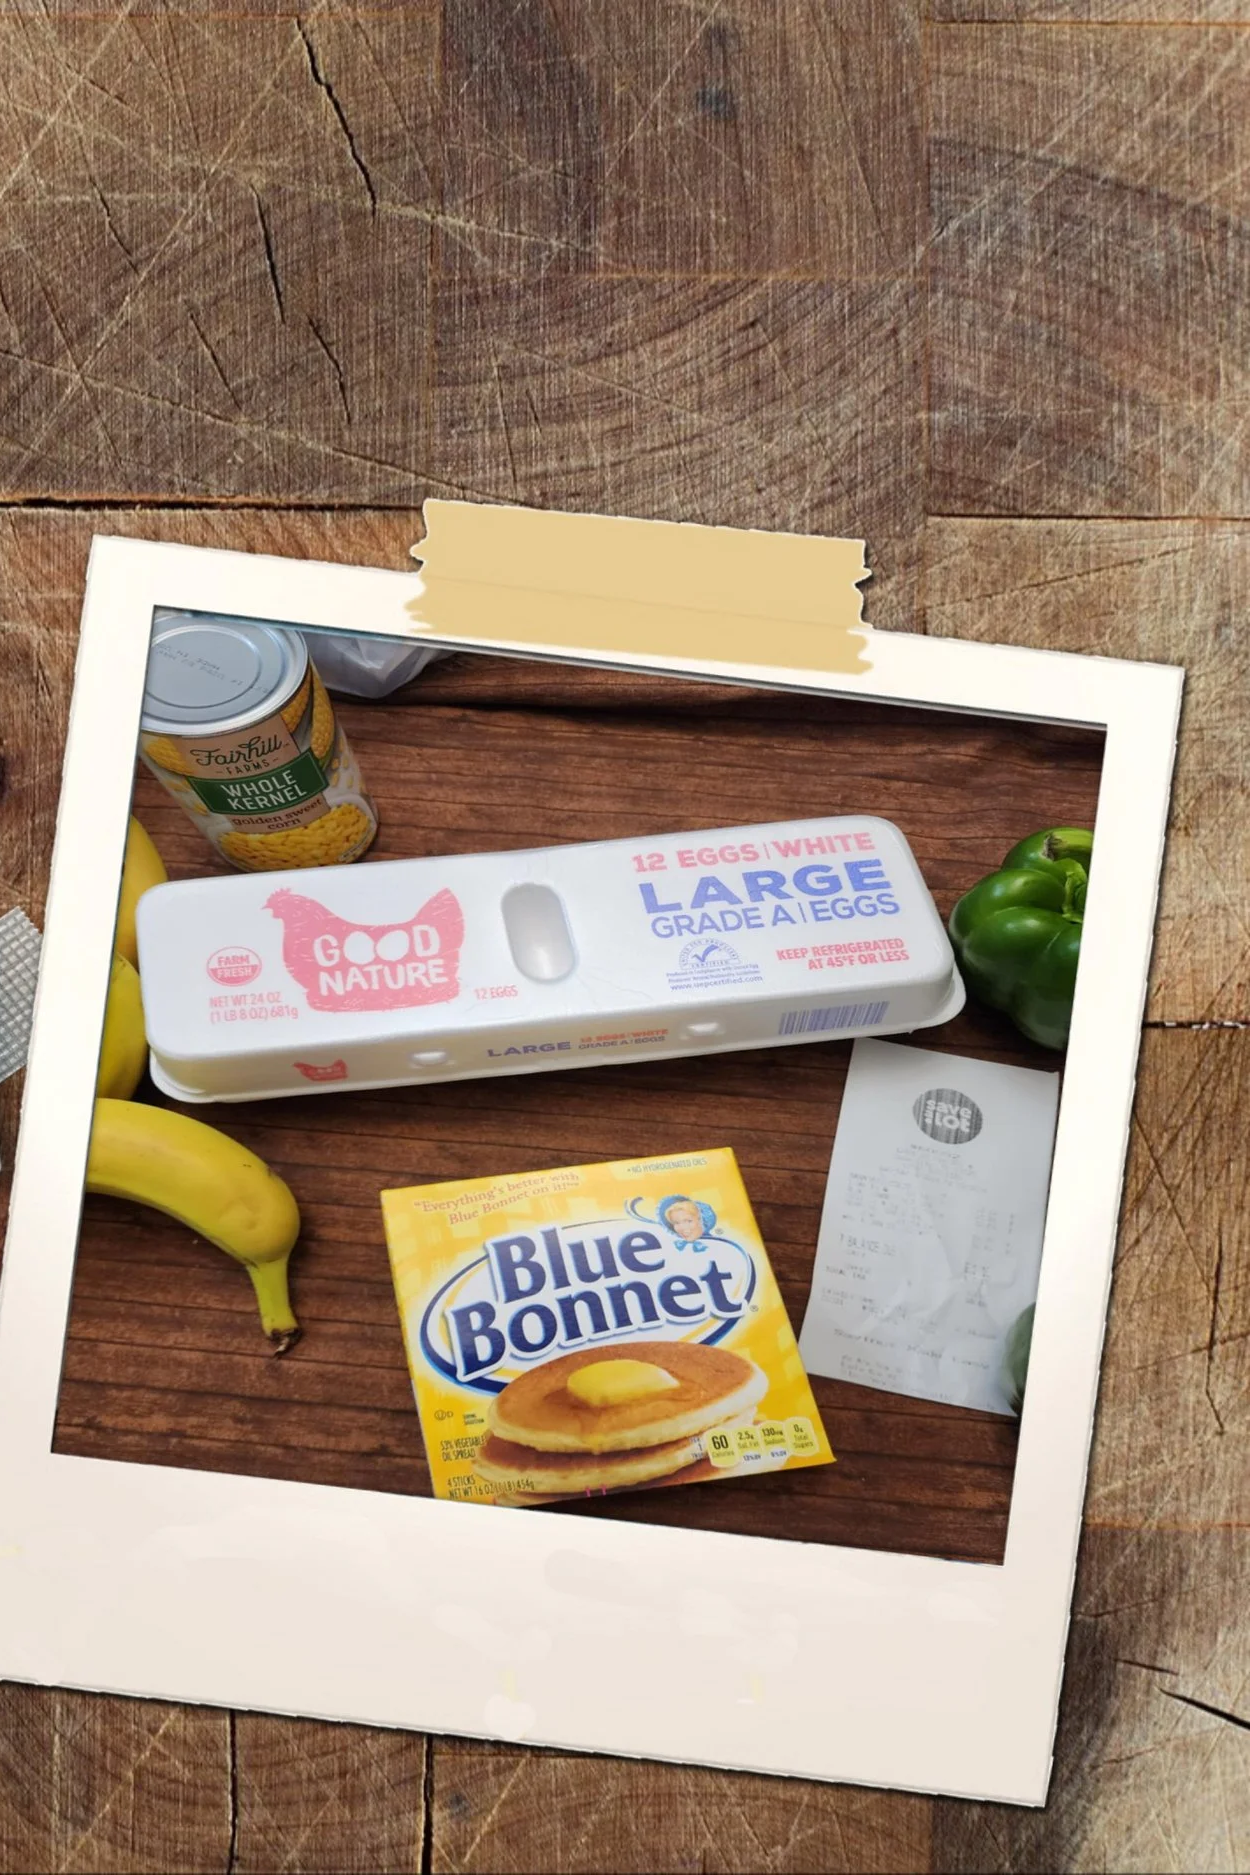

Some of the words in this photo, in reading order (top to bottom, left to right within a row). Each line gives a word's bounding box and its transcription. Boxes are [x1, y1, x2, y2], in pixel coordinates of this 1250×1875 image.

[190, 734, 282, 766] Fairhill
[226, 760, 270, 775] FARMS
[220, 770, 296, 798] WHOLE
[227, 785, 307, 811] KERNEL
[285, 797, 322, 819] sweet
[267, 818, 301, 831] corn
[632, 852, 667, 873] 12
[676, 843, 760, 869] EGGS
[770, 832, 876, 858] WHITE
[638, 858, 892, 915] LARGE
[651, 906, 764, 939] GRADE
[771, 904, 797, 927] A
[811, 893, 900, 922] EGGS
[313, 924, 441, 967] GOOD
[776, 947, 808, 960] KEEP
[811, 938, 905, 957] REFRIGERATED
[217, 954, 250, 967] FARM
[808, 959, 823, 970] AT
[858, 953, 878, 965] OR
[880, 950, 910, 962] LESS
[217, 966, 251, 979] FRESH
[319, 959, 447, 997] NATURE
[210, 996, 228, 1008] NET
[231, 994, 247, 1006] WT
[250, 993, 264, 1005] 24
[266, 991, 281, 1003] OZ
[474, 988, 488, 1000] 12
[490, 985, 519, 999] EGGS
[224, 1009, 237, 1021] LB
[239, 1008, 247, 1020] 8
[270, 1005, 299, 1020] 681g
[487, 1041, 571, 1058] LARGE
[578, 1040, 618, 1050] GRADE
[507, 1177, 546, 1193] better
[549, 1171, 579, 1182] with
[449, 1209, 479, 1225] Blue
[482, 1189, 529, 1213] Bonnet
[533, 1186, 549, 1195] on
[490, 1227, 667, 1304] Blue
[450, 1260, 743, 1377] Bonnet
[454, 1435, 487, 1449] VEGETABLE
[711, 1434, 729, 1450] 60
[449, 1488, 461, 1499] NET
[463, 1486, 473, 1498] WT
[475, 1485, 484, 1497] 16
[517, 1478, 535, 1491] 454g
[452, 1474, 476, 1487] STICKS
